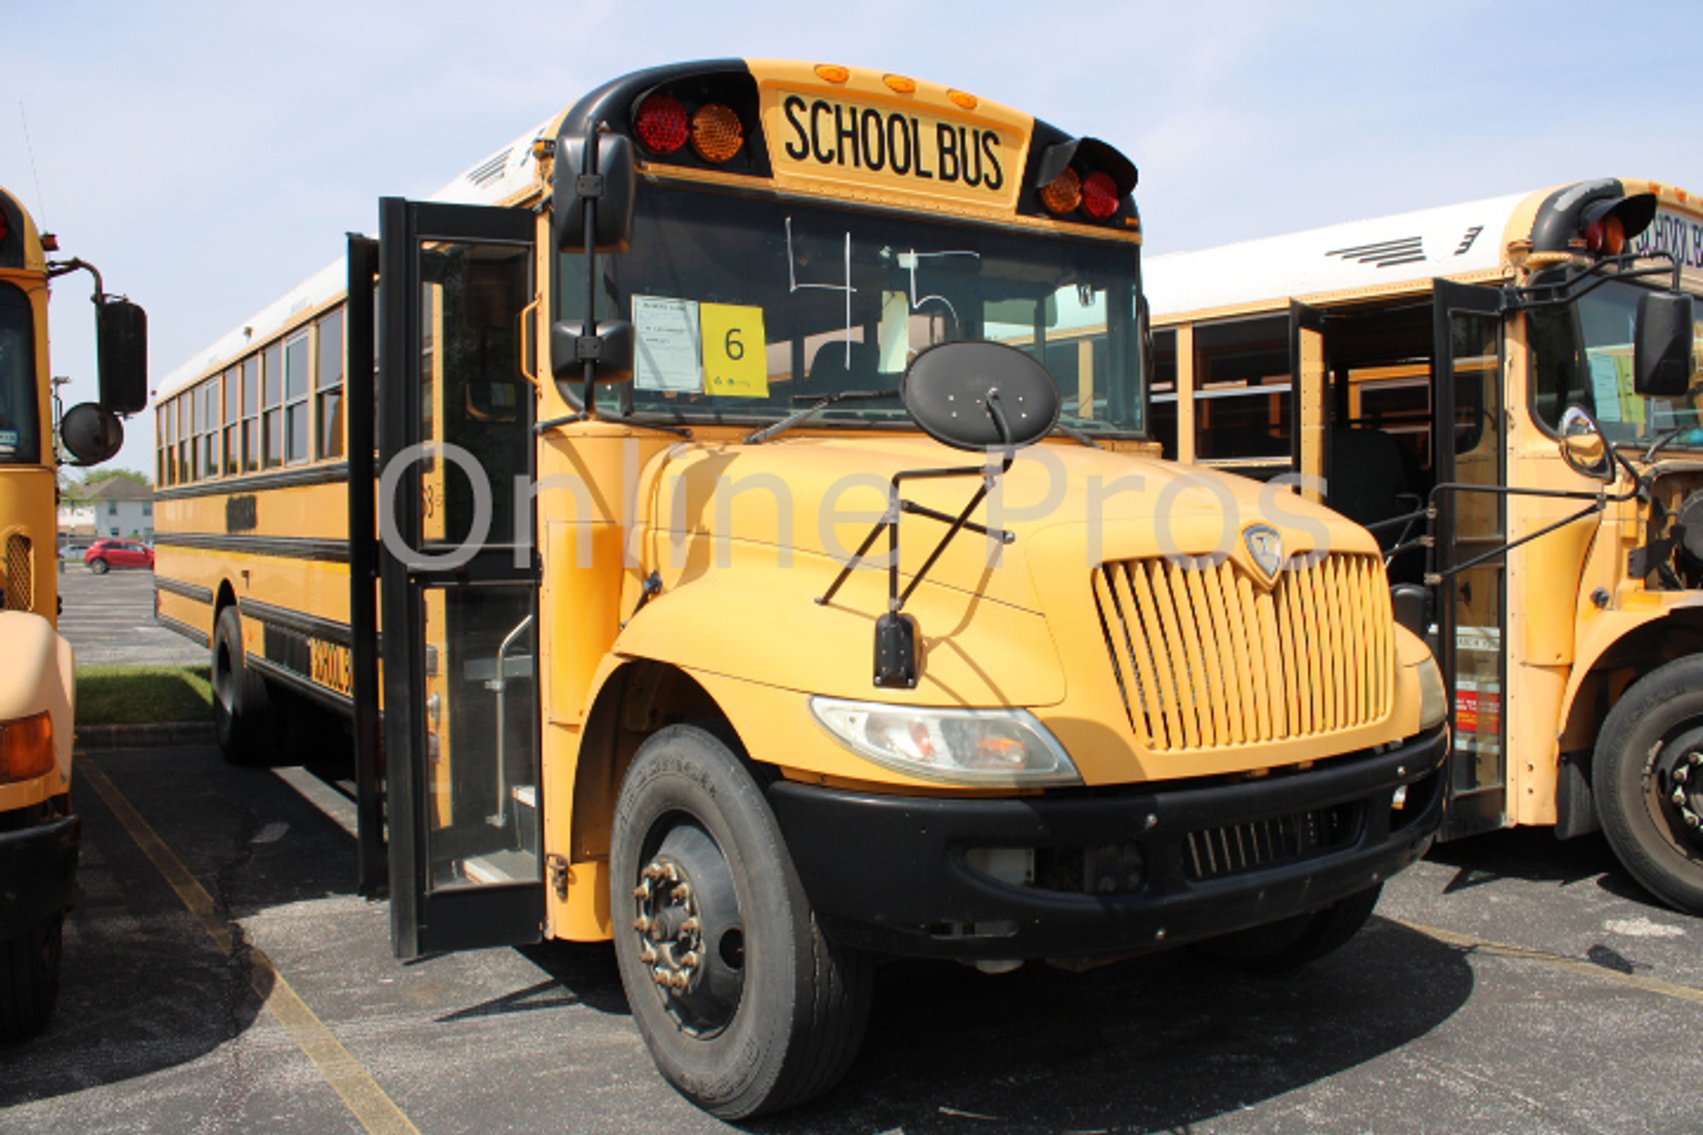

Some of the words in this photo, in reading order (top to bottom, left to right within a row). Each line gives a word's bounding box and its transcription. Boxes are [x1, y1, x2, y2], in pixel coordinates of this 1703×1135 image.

[784, 95, 933, 179] SCHOOL
[936, 122, 1003, 191] BUS
[725, 327, 745, 361] 6
